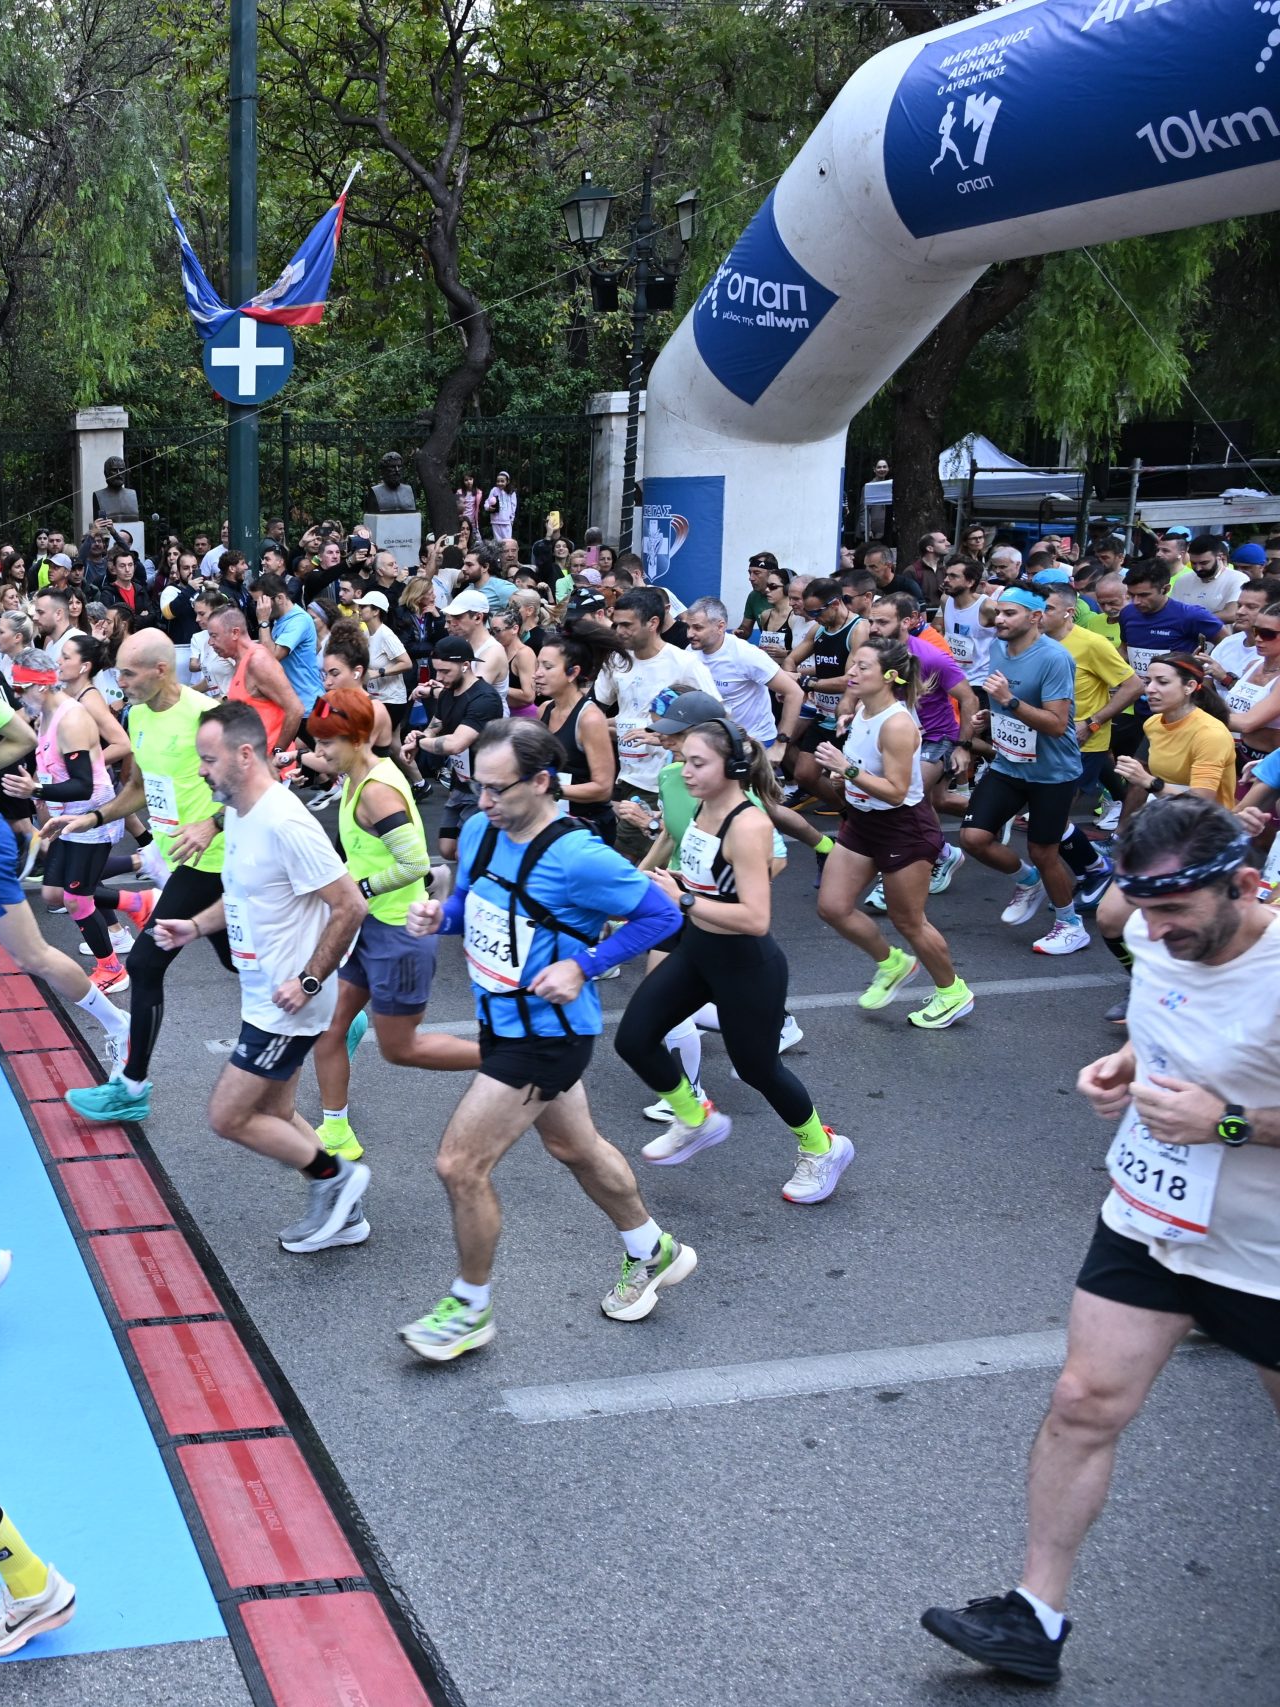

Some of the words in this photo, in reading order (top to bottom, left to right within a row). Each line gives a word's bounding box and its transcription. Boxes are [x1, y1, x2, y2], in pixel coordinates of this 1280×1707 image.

[939, 27, 1034, 69] ΜΑΡΑΘΩΝΙΟΣ
[945, 65, 1007, 93] ΑΥΘΕΝΤΙΚΟΣ
[948, 50, 1007, 80] ΑΘΗΝΑΣ
[1135, 106, 1280, 164] 10km
[756, 312, 809, 333] allwyn
[996, 728, 1027, 748] 32493
